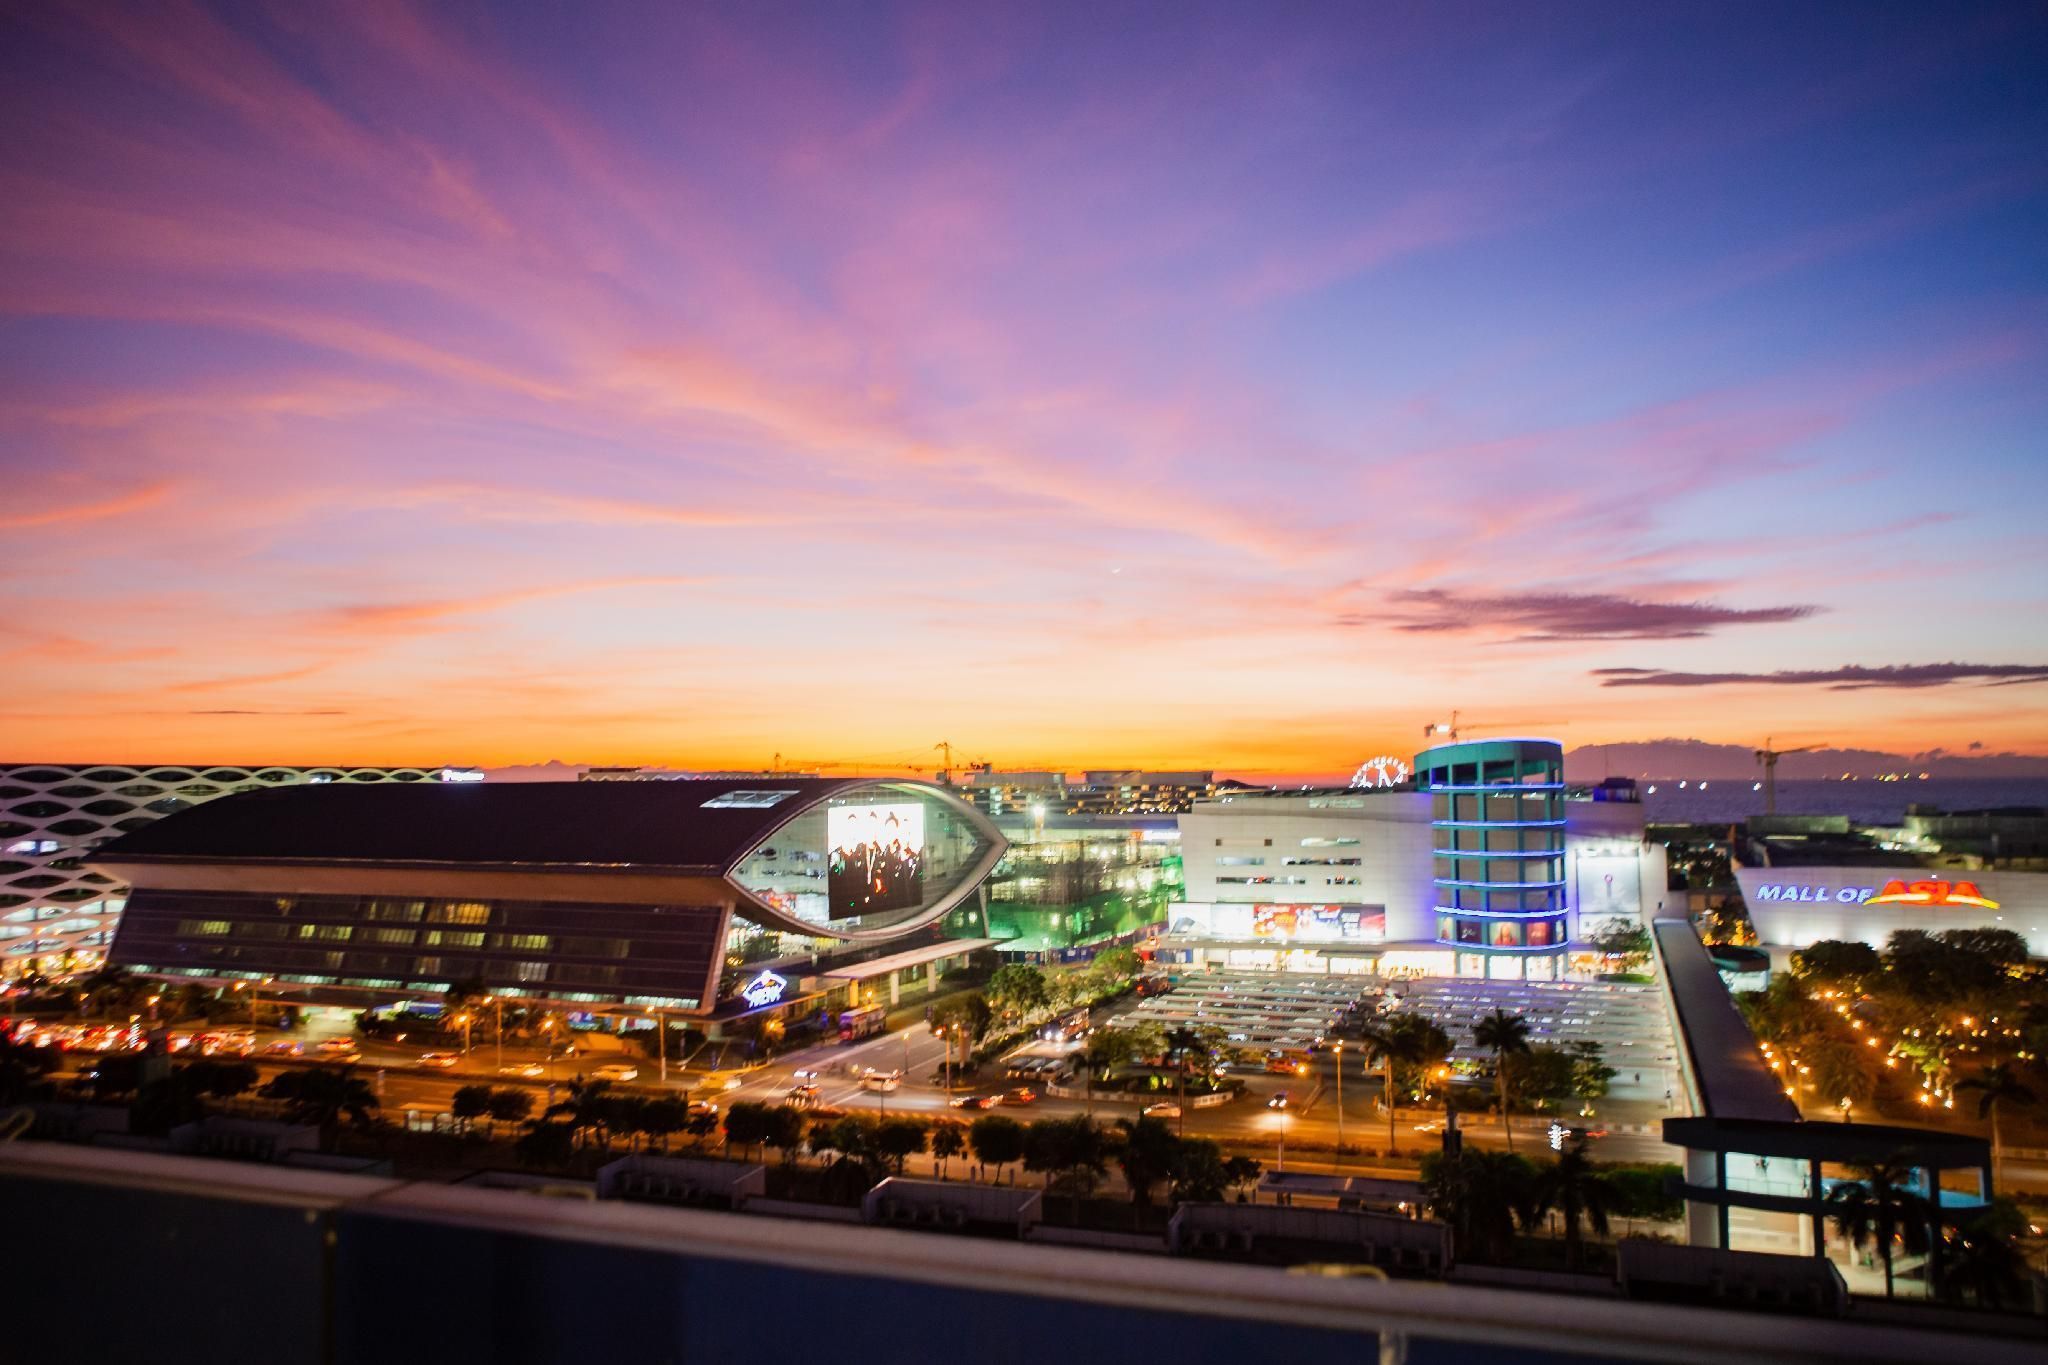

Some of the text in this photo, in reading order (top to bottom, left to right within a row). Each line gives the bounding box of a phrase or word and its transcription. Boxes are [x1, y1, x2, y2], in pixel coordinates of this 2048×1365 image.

[1756, 879, 1988, 908] MALL OF ASIA
